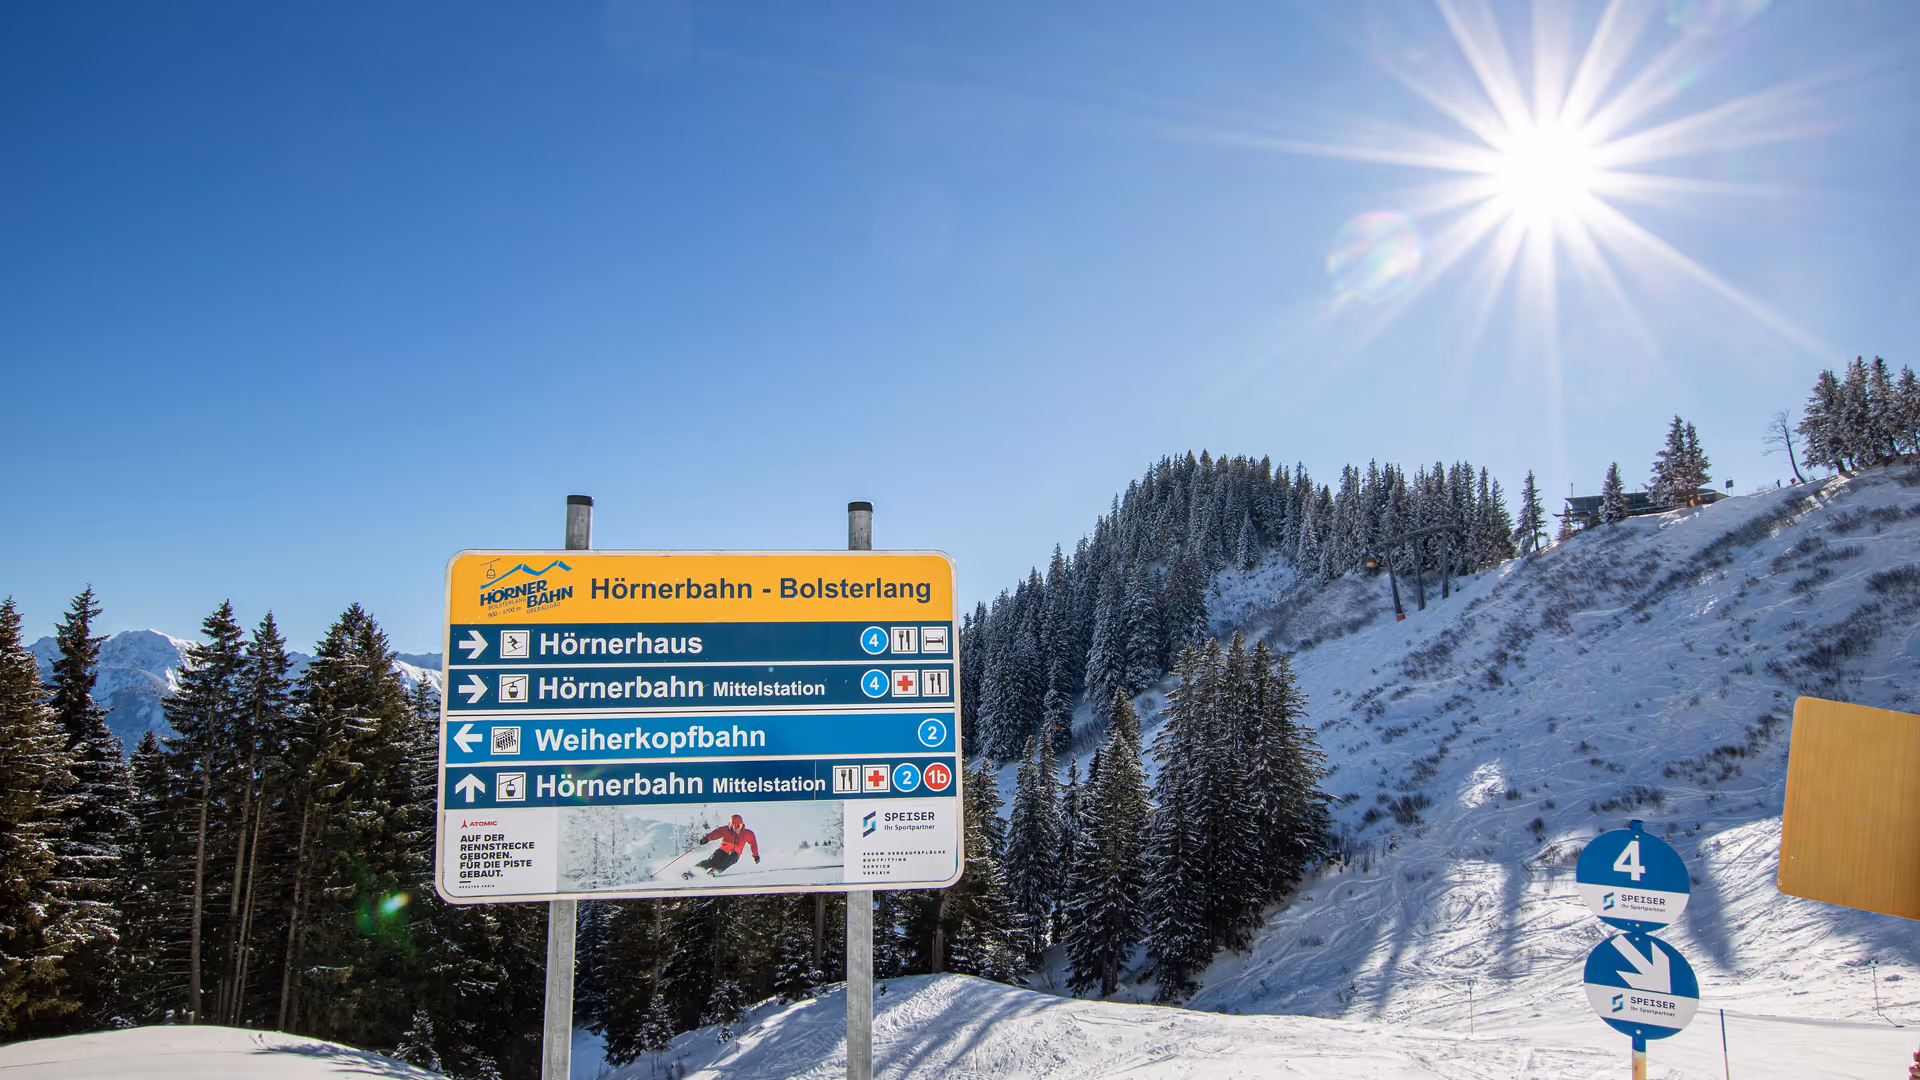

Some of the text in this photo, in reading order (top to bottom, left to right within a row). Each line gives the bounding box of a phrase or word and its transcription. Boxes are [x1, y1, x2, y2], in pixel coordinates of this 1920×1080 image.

[480, 579, 547, 606] HÖRNER
[527, 585, 573, 608] BAHN
[591, 578, 752, 600] Hörnerbahn
[780, 577, 931, 603] Bolsterlang
[540, 632, 703, 655] Hörnerhaus
[869, 634, 879, 647] 4
[538, 676, 825, 699] Hörnerbahn Mittelstation
[869, 677, 879, 690] 4
[536, 725, 766, 753] Weiherkopfbahn
[927, 727, 938, 740] 2
[902, 771, 912, 784] 2
[928, 770, 947, 784] 1b
[537, 772, 825, 798] Hörnerbahn Mittelstation
[884, 812, 935, 821] SPEISER
[460, 842, 535, 851] RENNSTRECKE
[460, 852, 512, 860] GEBOREN.
[1613, 840, 1646, 881] 4
[460, 860, 532, 869] FÜR DIE PISTE
[459, 870, 503, 878] GEBAUT.
[1621, 894, 1666, 906] SPEISER
[1630, 996, 1676, 1010] SPEISER
